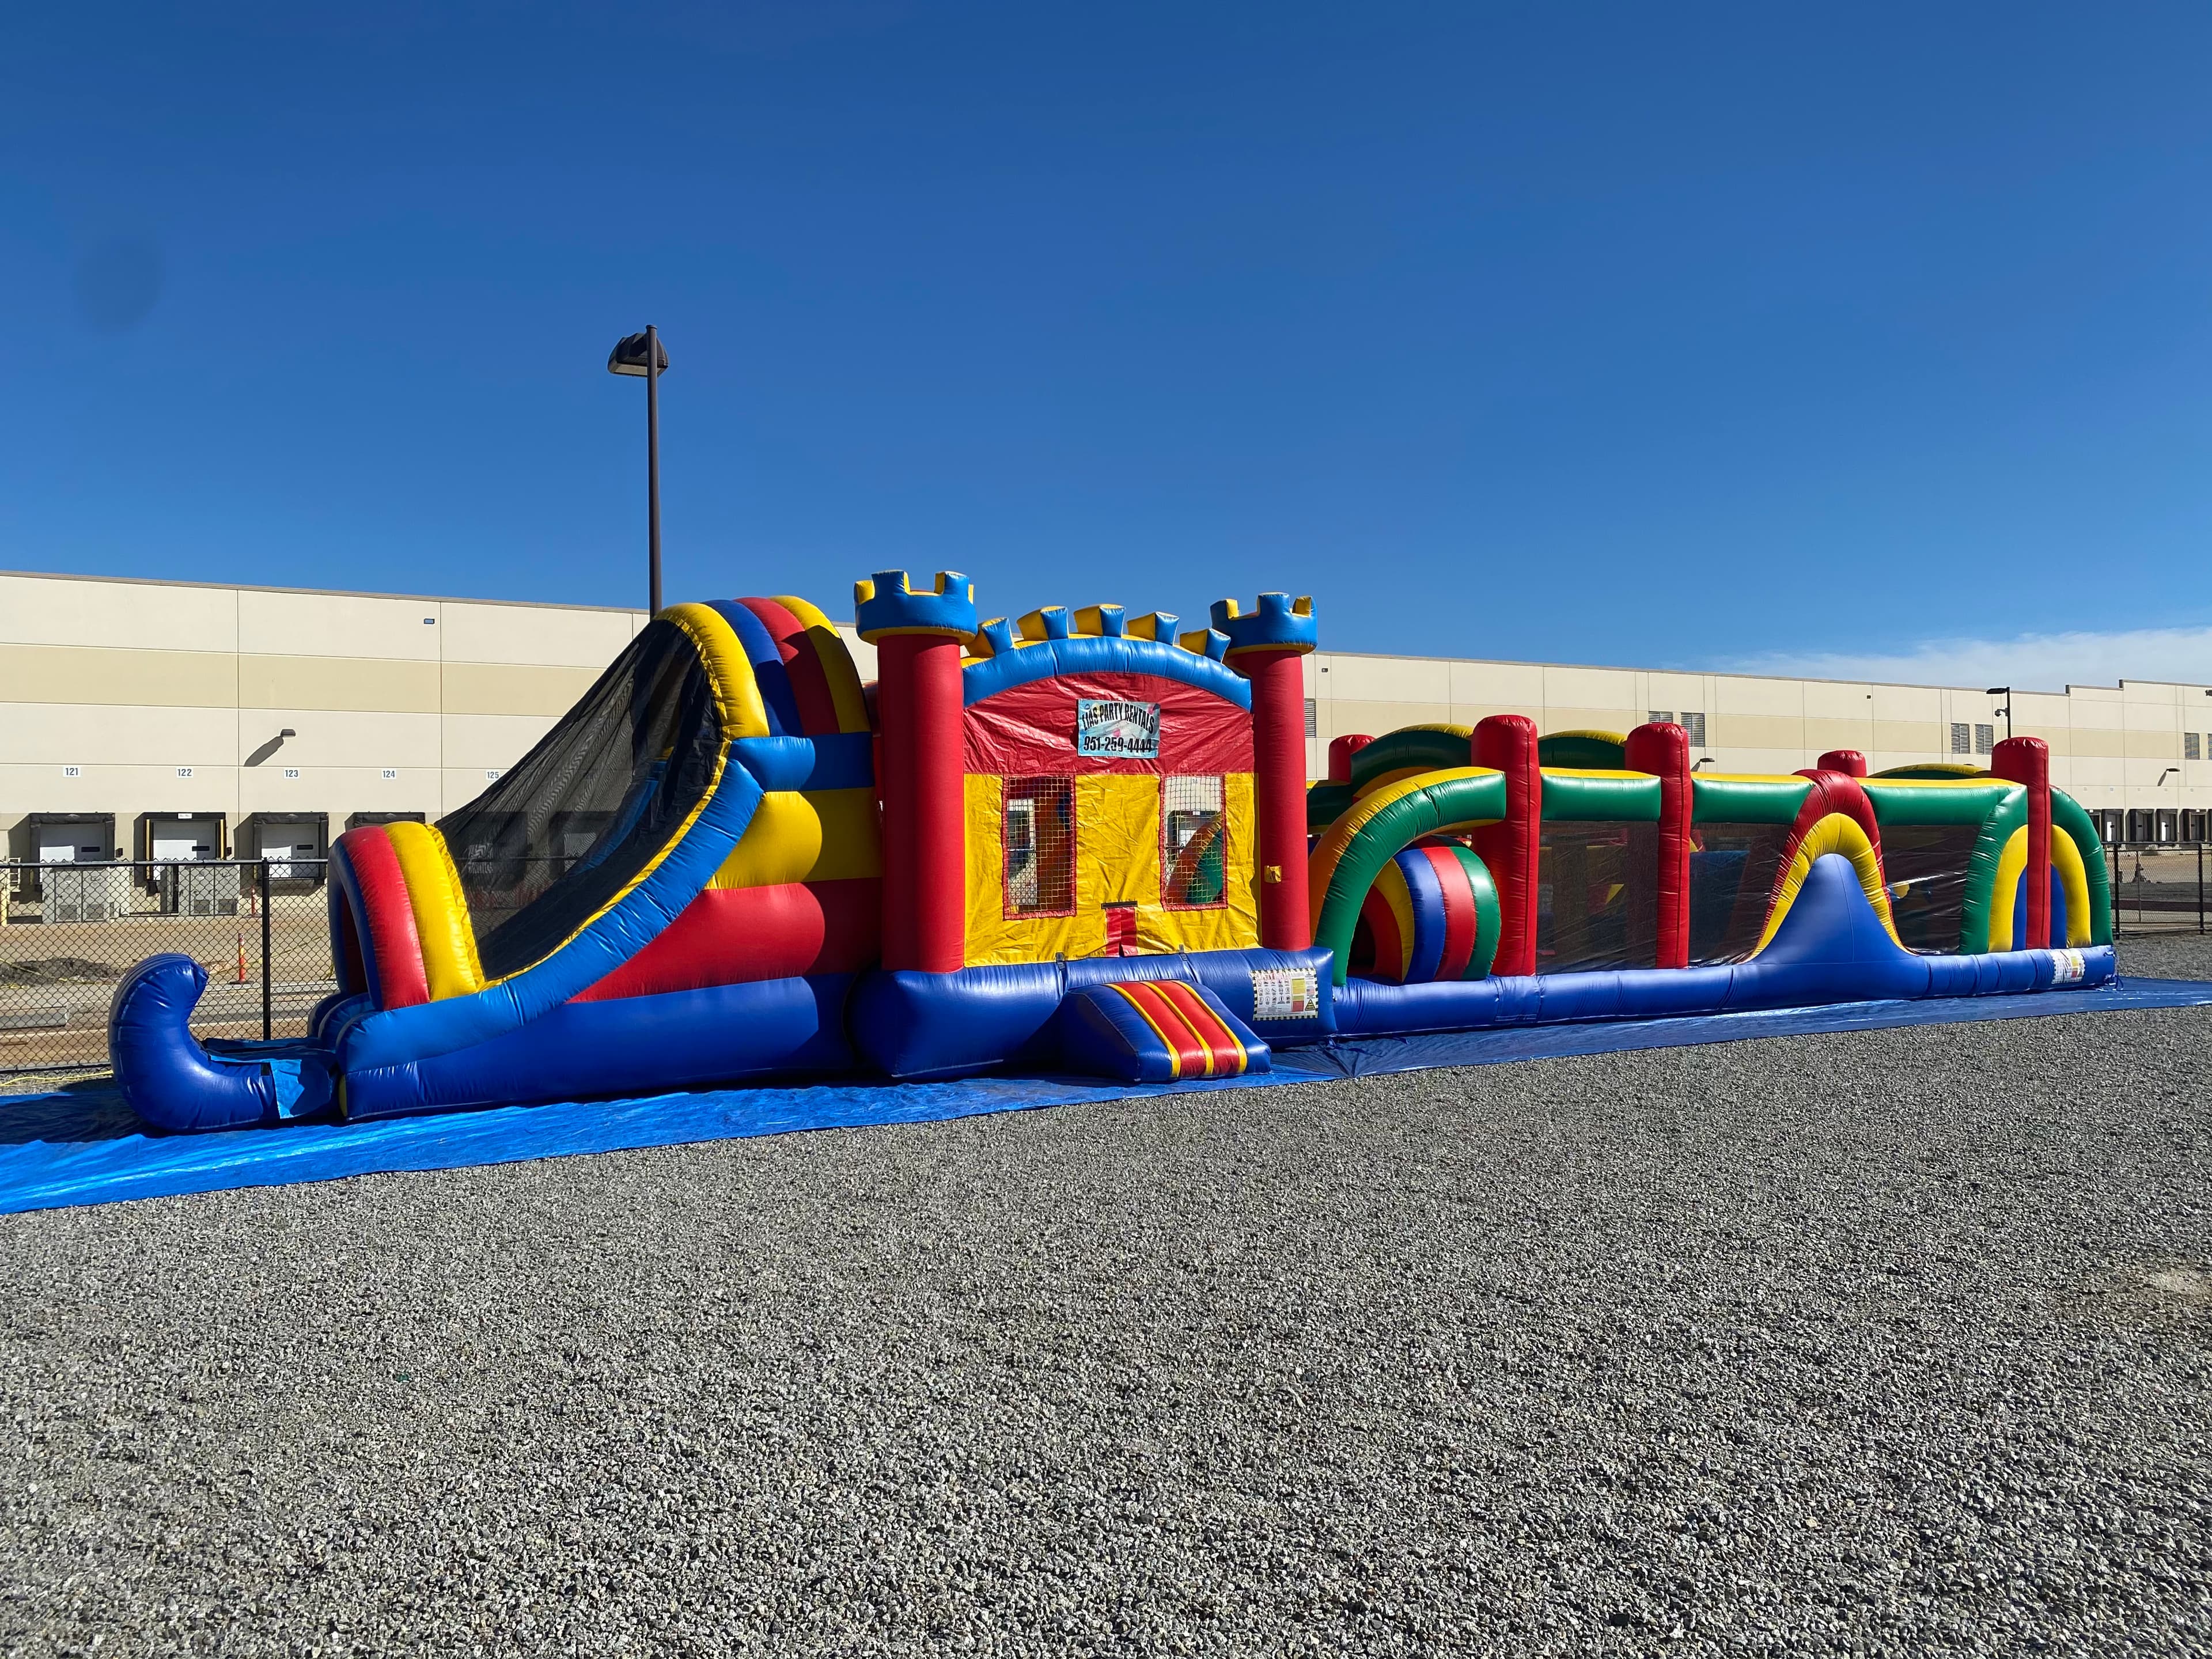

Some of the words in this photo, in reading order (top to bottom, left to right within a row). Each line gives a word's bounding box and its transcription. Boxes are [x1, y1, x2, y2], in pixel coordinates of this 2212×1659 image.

[1082, 707, 1099, 732] LIAS
[1099, 702, 1123, 722] PARTY
[1124, 703, 1154, 734] RENTALS
[1083, 736, 1153, 753] 951-259-4444
[65, 767, 78, 776] 121
[177, 768, 192, 777] 122
[285, 770, 298, 778] 123
[382, 770, 395, 778] 124
